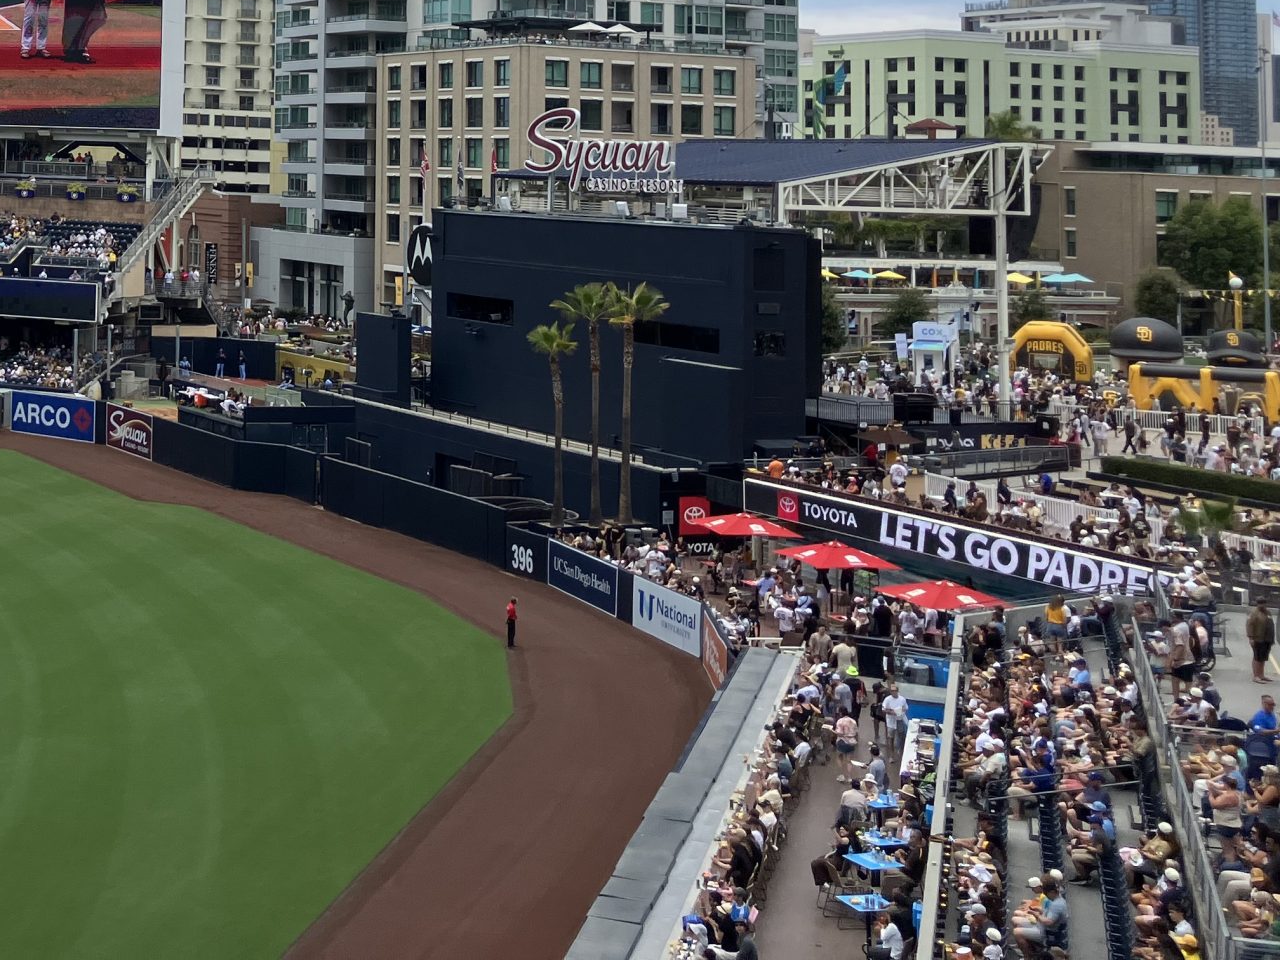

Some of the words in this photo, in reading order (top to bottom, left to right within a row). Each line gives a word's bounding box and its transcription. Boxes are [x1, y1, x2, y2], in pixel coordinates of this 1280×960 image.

[523, 107, 675, 192] Sycuan
[586, 178, 627, 191] CASINO
[639, 179, 684, 193] RESORT
[1026, 340, 1064, 354] PADRES
[13, 401, 71, 429] ARCO
[109, 410, 148, 448] Sycuan
[802, 502, 858, 528] TOYOTA
[687, 542, 714, 553] YOTA
[879, 512, 957, 561] LET'S
[963, 533, 1019, 575] GO
[511, 544, 534, 574] 396
[553, 556, 563, 573] UC
[563, 560, 574, 578] San
[574, 565, 591, 587] Diego
[591, 573, 611, 595] Health
[656, 598, 696, 630] National
